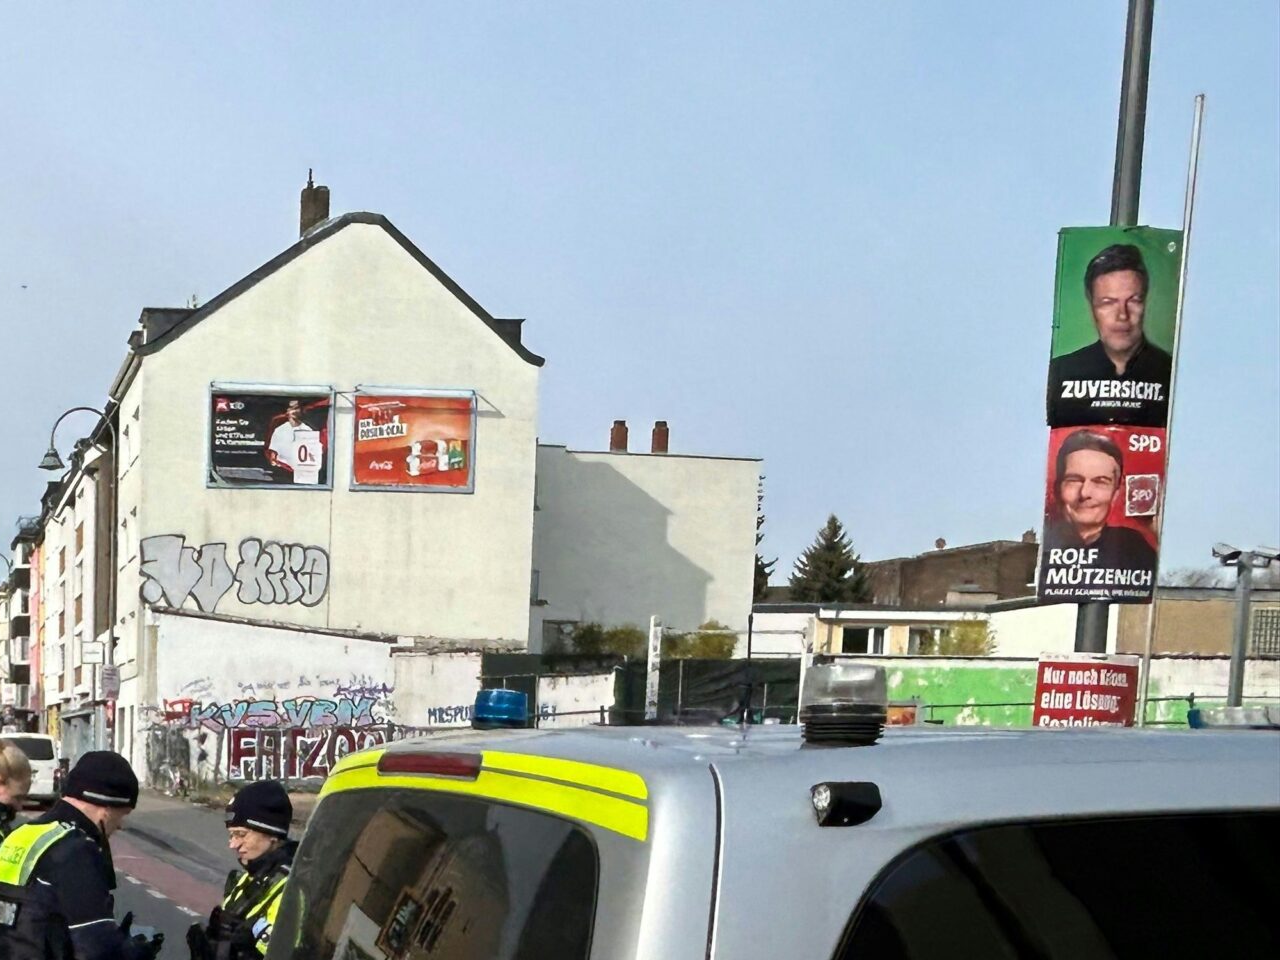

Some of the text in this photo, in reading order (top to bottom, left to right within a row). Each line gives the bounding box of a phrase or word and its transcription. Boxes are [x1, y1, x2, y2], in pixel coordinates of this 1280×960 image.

[1128, 434, 1161, 452] SPD
[1049, 548, 1099, 565] ROLF
[1046, 565, 1152, 585] MÜTZENICH
[1043, 666, 1065, 684] Nur
[1068, 669, 1098, 685] noch
[1041, 689, 1073, 709] eine
